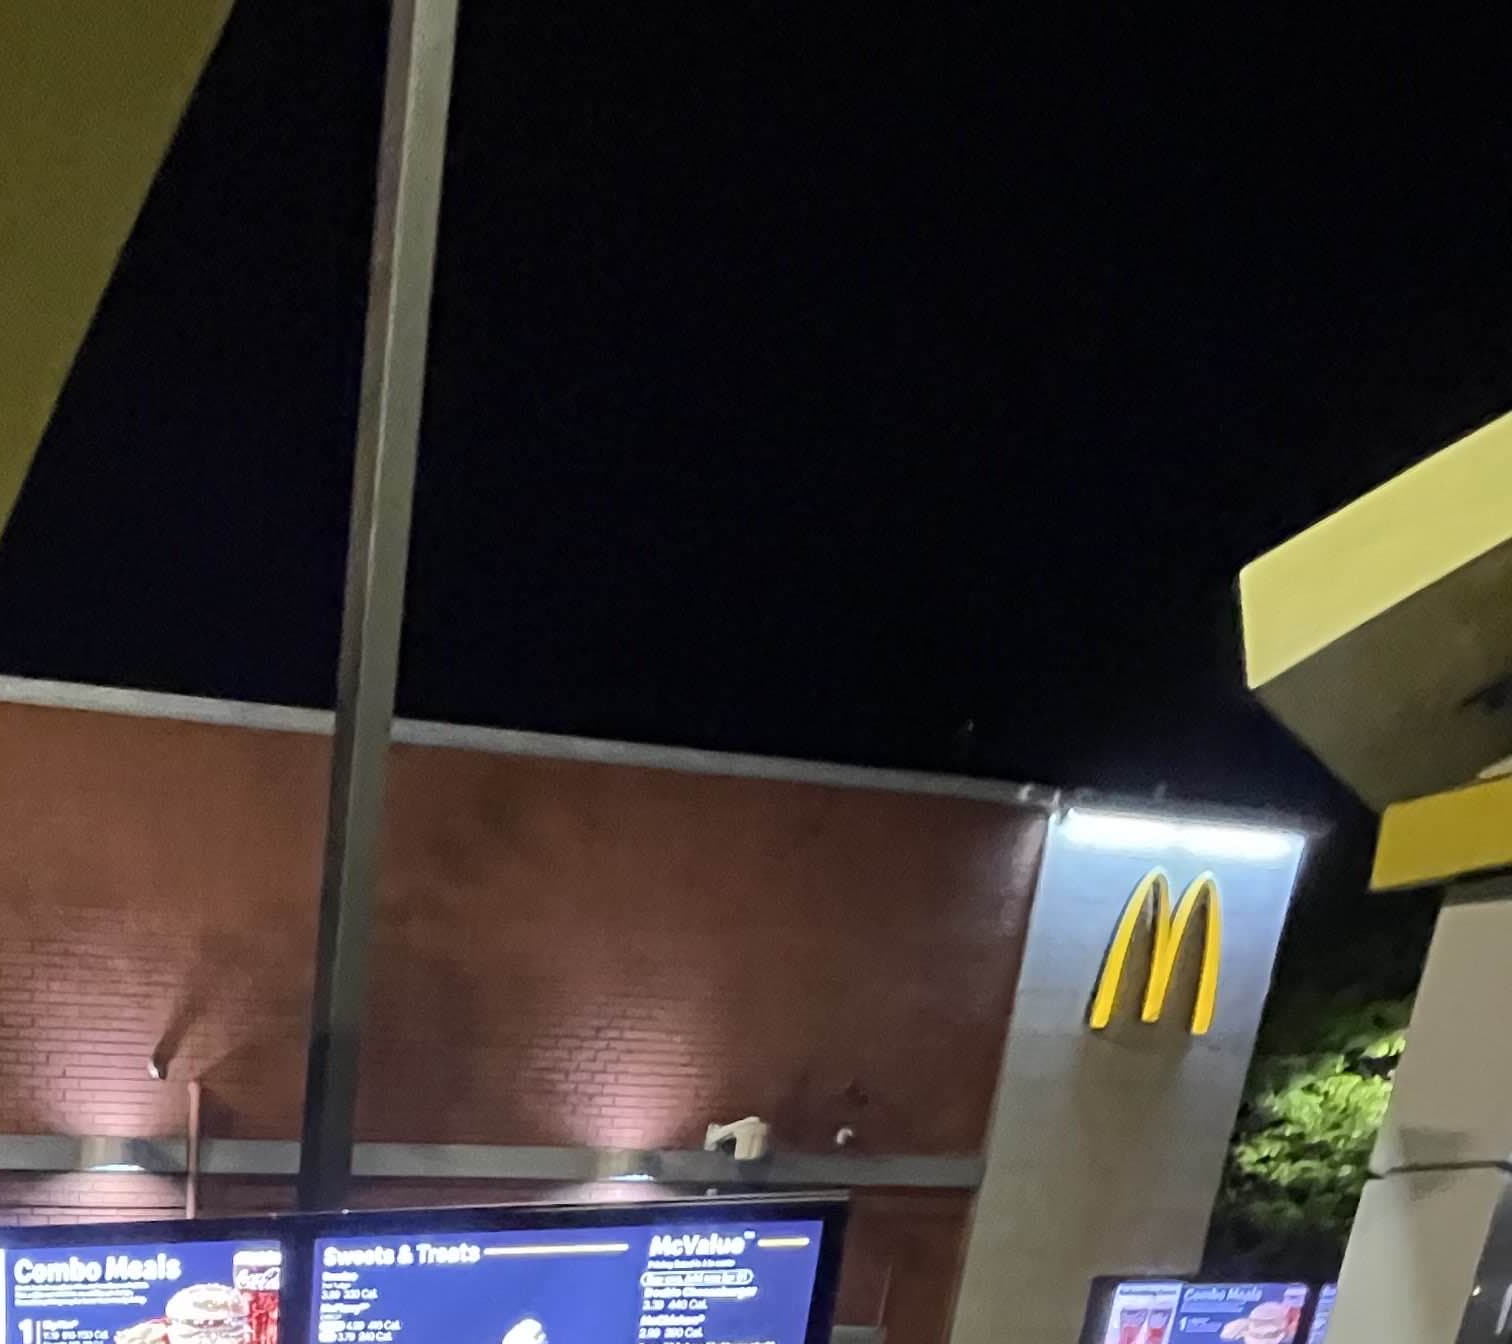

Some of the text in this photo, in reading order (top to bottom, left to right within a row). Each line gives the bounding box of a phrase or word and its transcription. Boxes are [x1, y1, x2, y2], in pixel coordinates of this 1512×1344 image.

[323, 1243, 481, 1266] Sweets & Treats
[14, 1253, 182, 1283] Combo Meals
